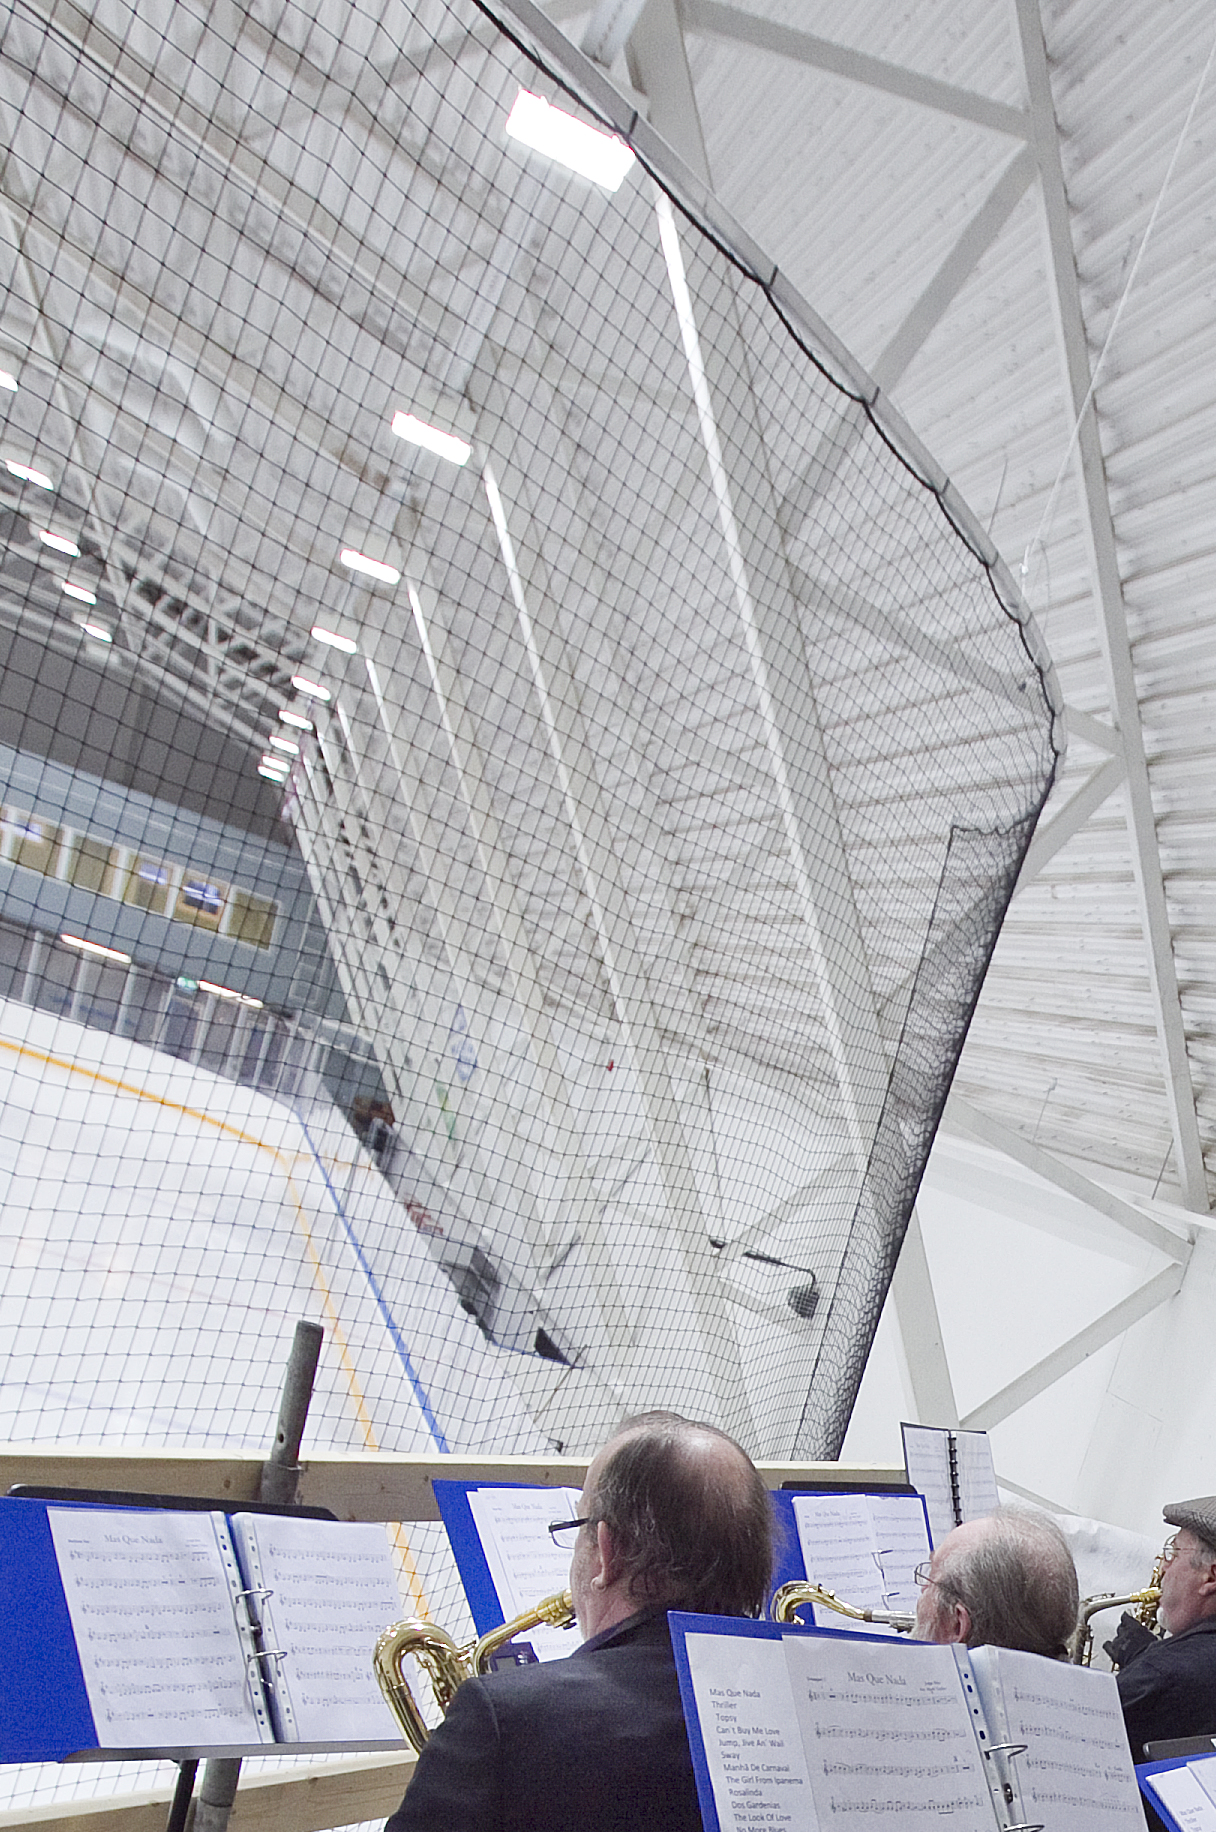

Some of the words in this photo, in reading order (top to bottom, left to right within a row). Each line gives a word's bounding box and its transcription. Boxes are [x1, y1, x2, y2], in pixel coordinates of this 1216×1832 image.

[847, 1671, 864, 1682] Mas
[866, 1672, 884, 1686] Que
[885, 1674, 906, 1685] Nada
[709, 1688, 725, 1697] Mas
[726, 1688, 741, 1698] Que
[743, 1689, 761, 1698] Nada
[711, 1700, 737, 1709] Thriller
[716, 1712, 737, 1722] Topsy
[737, 1726, 751, 1736] Buy
[752, 1726, 763, 1735] Me
[765, 1727, 780, 1736] Love
[721, 1751, 740, 1760] Sway
[751, 1763, 760, 1771] De
[761, 1763, 790, 1772] Carnaval
[725, 1775, 740, 1784] The
[741, 1775, 754, 1784] Girl
[755, 1776, 773, 1784] From
[774, 1776, 803, 1785] Ipanema
[728, 1788, 762, 1796] Rosalinda
[731, 1801, 746, 1809] Dos
[746, 1801, 780, 1809] Gardenias
[734, 1813, 747, 1821] The
[748, 1814, 765, 1822] Look
[766, 1813, 774, 1821] Of
